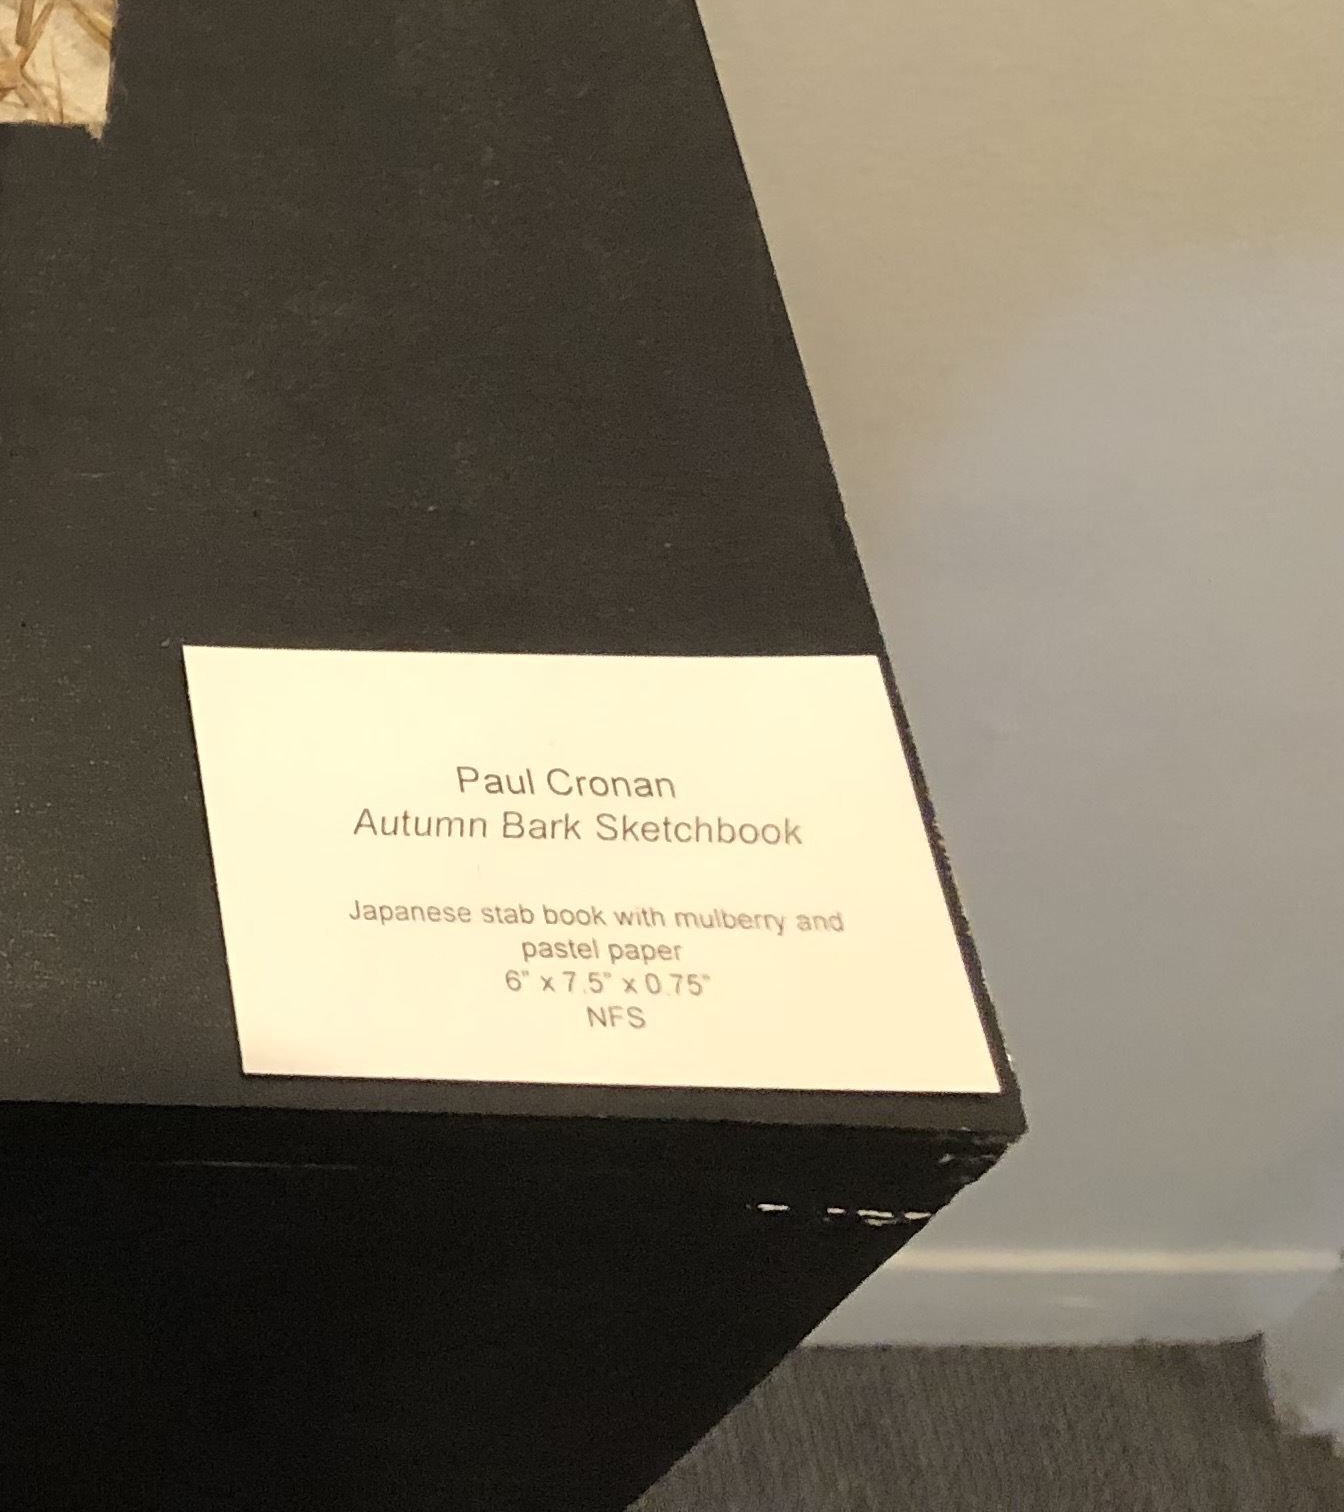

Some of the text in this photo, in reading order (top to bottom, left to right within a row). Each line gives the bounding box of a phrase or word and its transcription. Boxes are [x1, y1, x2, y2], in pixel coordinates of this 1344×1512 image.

[456, 765, 676, 799] Paul Cronan
[353, 807, 803, 846] Autumn Bark Sketchbook
[348, 899, 845, 937] Japanese stab book with mulberry and
[521, 937, 682, 966] pastel paper
[540, 975, 556, 992] x
[622, 977, 638, 994] x
[586, 1005, 647, 1030] NFS
